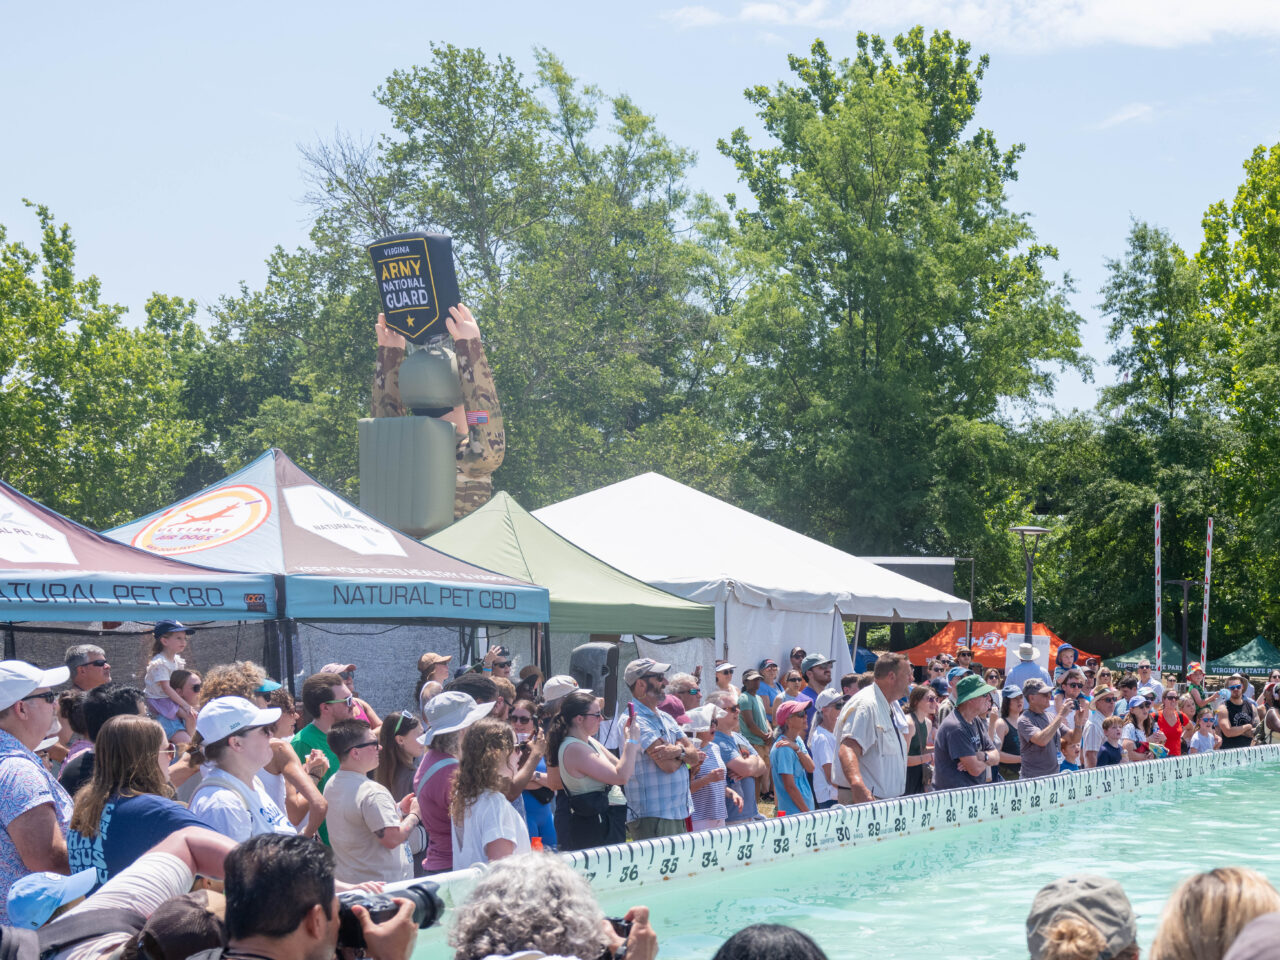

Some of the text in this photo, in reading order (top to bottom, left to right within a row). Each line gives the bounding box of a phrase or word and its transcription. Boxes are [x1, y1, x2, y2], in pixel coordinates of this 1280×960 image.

[384, 246, 410, 256] VIRGINIA
[382, 260, 421, 280] ARMY
[382, 278, 426, 292] NATIONAL
[385, 290, 429, 309] GUARD
[0, 582, 225, 607] TURAL PET CBD
[333, 585, 517, 610] NATURAL PET CBD
[956, 636, 1008, 647] SHOK
[619, 864, 639, 883] 36
[660, 857, 680, 875] 35
[701, 851, 719, 868] 34
[737, 843, 754, 861] 33
[773, 838, 790, 854] 32
[805, 831, 818, 848] 31
[836, 826, 851, 842] 30
[868, 822, 881, 837] 29
[894, 817, 907, 832] 28
[921, 813, 931, 828] 27
[946, 808, 957, 823] 26
[968, 805, 979, 819] 25
[990, 802, 999, 815] 24
[1011, 799, 1022, 812] 23
[1030, 795, 1041, 808] 22
[1049, 792, 1059, 804] 21
